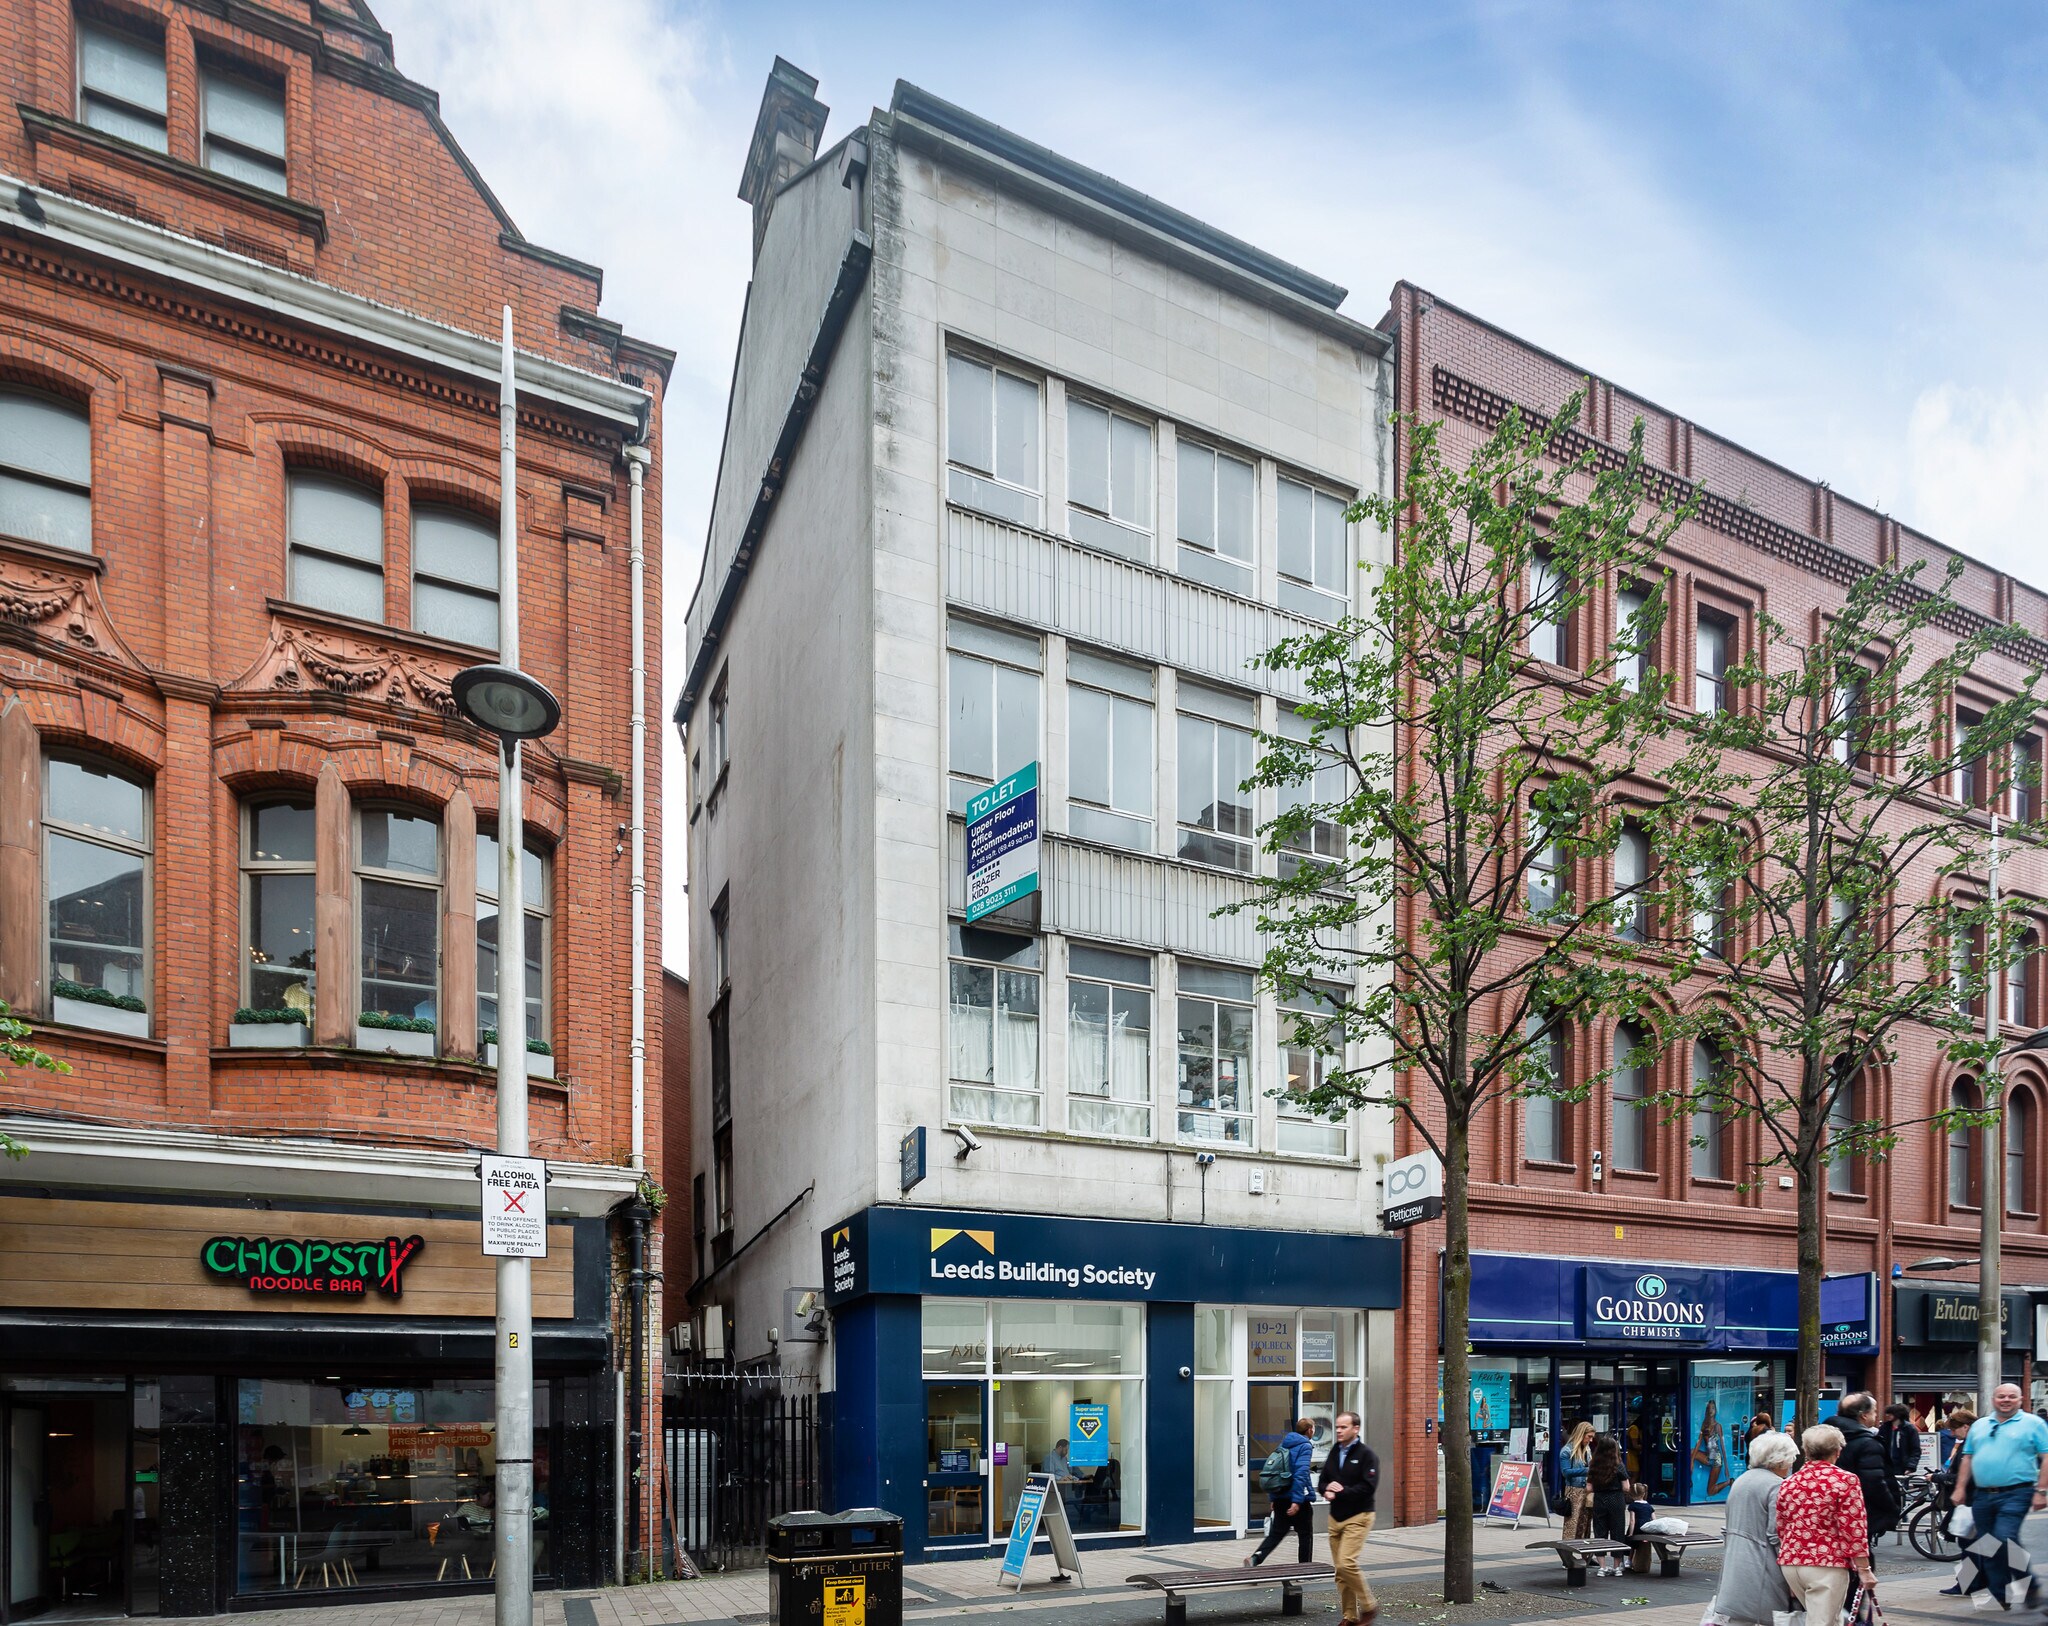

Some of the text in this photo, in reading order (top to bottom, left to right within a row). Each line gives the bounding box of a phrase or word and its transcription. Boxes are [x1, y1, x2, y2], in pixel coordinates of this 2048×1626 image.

[972, 778, 1016, 816] TO LET
[972, 806, 1015, 838] Upper Floor
[972, 831, 992, 848] Office
[972, 820, 1034, 860] Accommodation
[972, 870, 1000, 892] FRAZER
[972, 886, 989, 901] KIDD
[972, 885, 1016, 913] 028 9023 3111
[491, 1170, 536, 1180] ALCOHOL
[487, 1178, 540, 1189] FREE AREA
[1390, 1205, 1423, 1222] Petticrew
[834, 1246, 850, 1264] Leeds
[206, 1240, 413, 1293] CHOPSTIX
[834, 1261, 855, 1278] Building
[931, 1258, 1156, 1290] Leeds Building Society
[250, 1276, 363, 1292] NOODLE BAR
[834, 1276, 854, 1292] Society
[1596, 1296, 1704, 1324] GORDONS
[1934, 1298, 2008, 1322] Enlan's
[1256, 1322, 1287, 1334] 19-21
[1623, 1326, 1680, 1337] CHEMISTS
[1820, 1330, 1868, 1342] GORDONS
[510, 1334, 517, 1347] 2
[1251, 1341, 1292, 1350] HOLBECK
[1257, 1355, 1286, 1364] HOUSE
[392, 1425, 457, 1434] INGRTS
[392, 1435, 488, 1445] FRESHLY PREPARED
[392, 1448, 424, 1456] EVERY
[852, 1562, 891, 1572] LITTER
